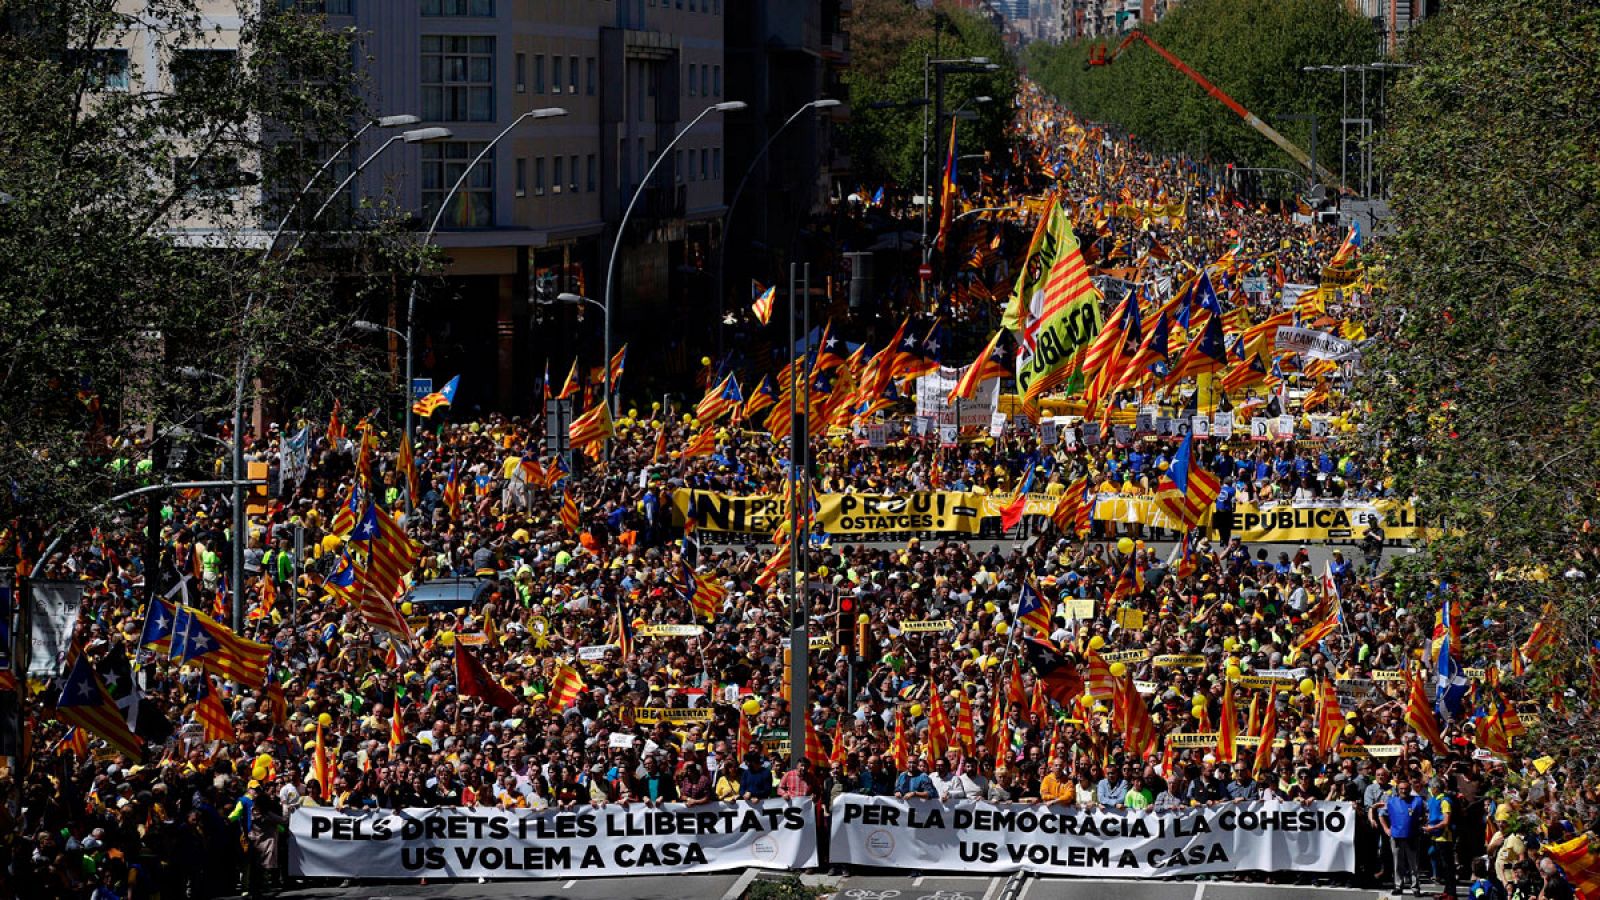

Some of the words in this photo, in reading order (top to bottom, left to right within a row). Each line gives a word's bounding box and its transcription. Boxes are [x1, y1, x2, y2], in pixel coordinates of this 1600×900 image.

[697, 494, 746, 531] NI
[840, 515, 933, 530] OSTATGES
[1230, 507, 1352, 531] EPÚBLICA
[904, 621, 948, 629] LLIBERTAT
[663, 709, 709, 717] LLIBERTAT
[1172, 735, 1220, 743] LLIBERTA
[311, 815, 393, 841] PELS
[401, 816, 510, 840] DRETS
[519, 817, 527, 840] I
[537, 814, 598, 840] LES
[606, 807, 805, 837] LLIBERTATS
[843, 803, 900, 826] PER
[907, 808, 946, 829] LA
[953, 808, 1150, 838] DEMOCRÀCIA
[1158, 819, 1166, 838] I
[1173, 815, 1211, 838] LA
[1218, 806, 1346, 833] COHESIÓ
[403, 847, 446, 870] US
[455, 845, 572, 870] VOLEM
[580, 844, 605, 869] A
[614, 842, 708, 868] CASA
[959, 841, 998, 863] US
[1006, 843, 1110, 868] VOLEM
[1117, 848, 1140, 869] A
[1146, 842, 1230, 868] CASA
